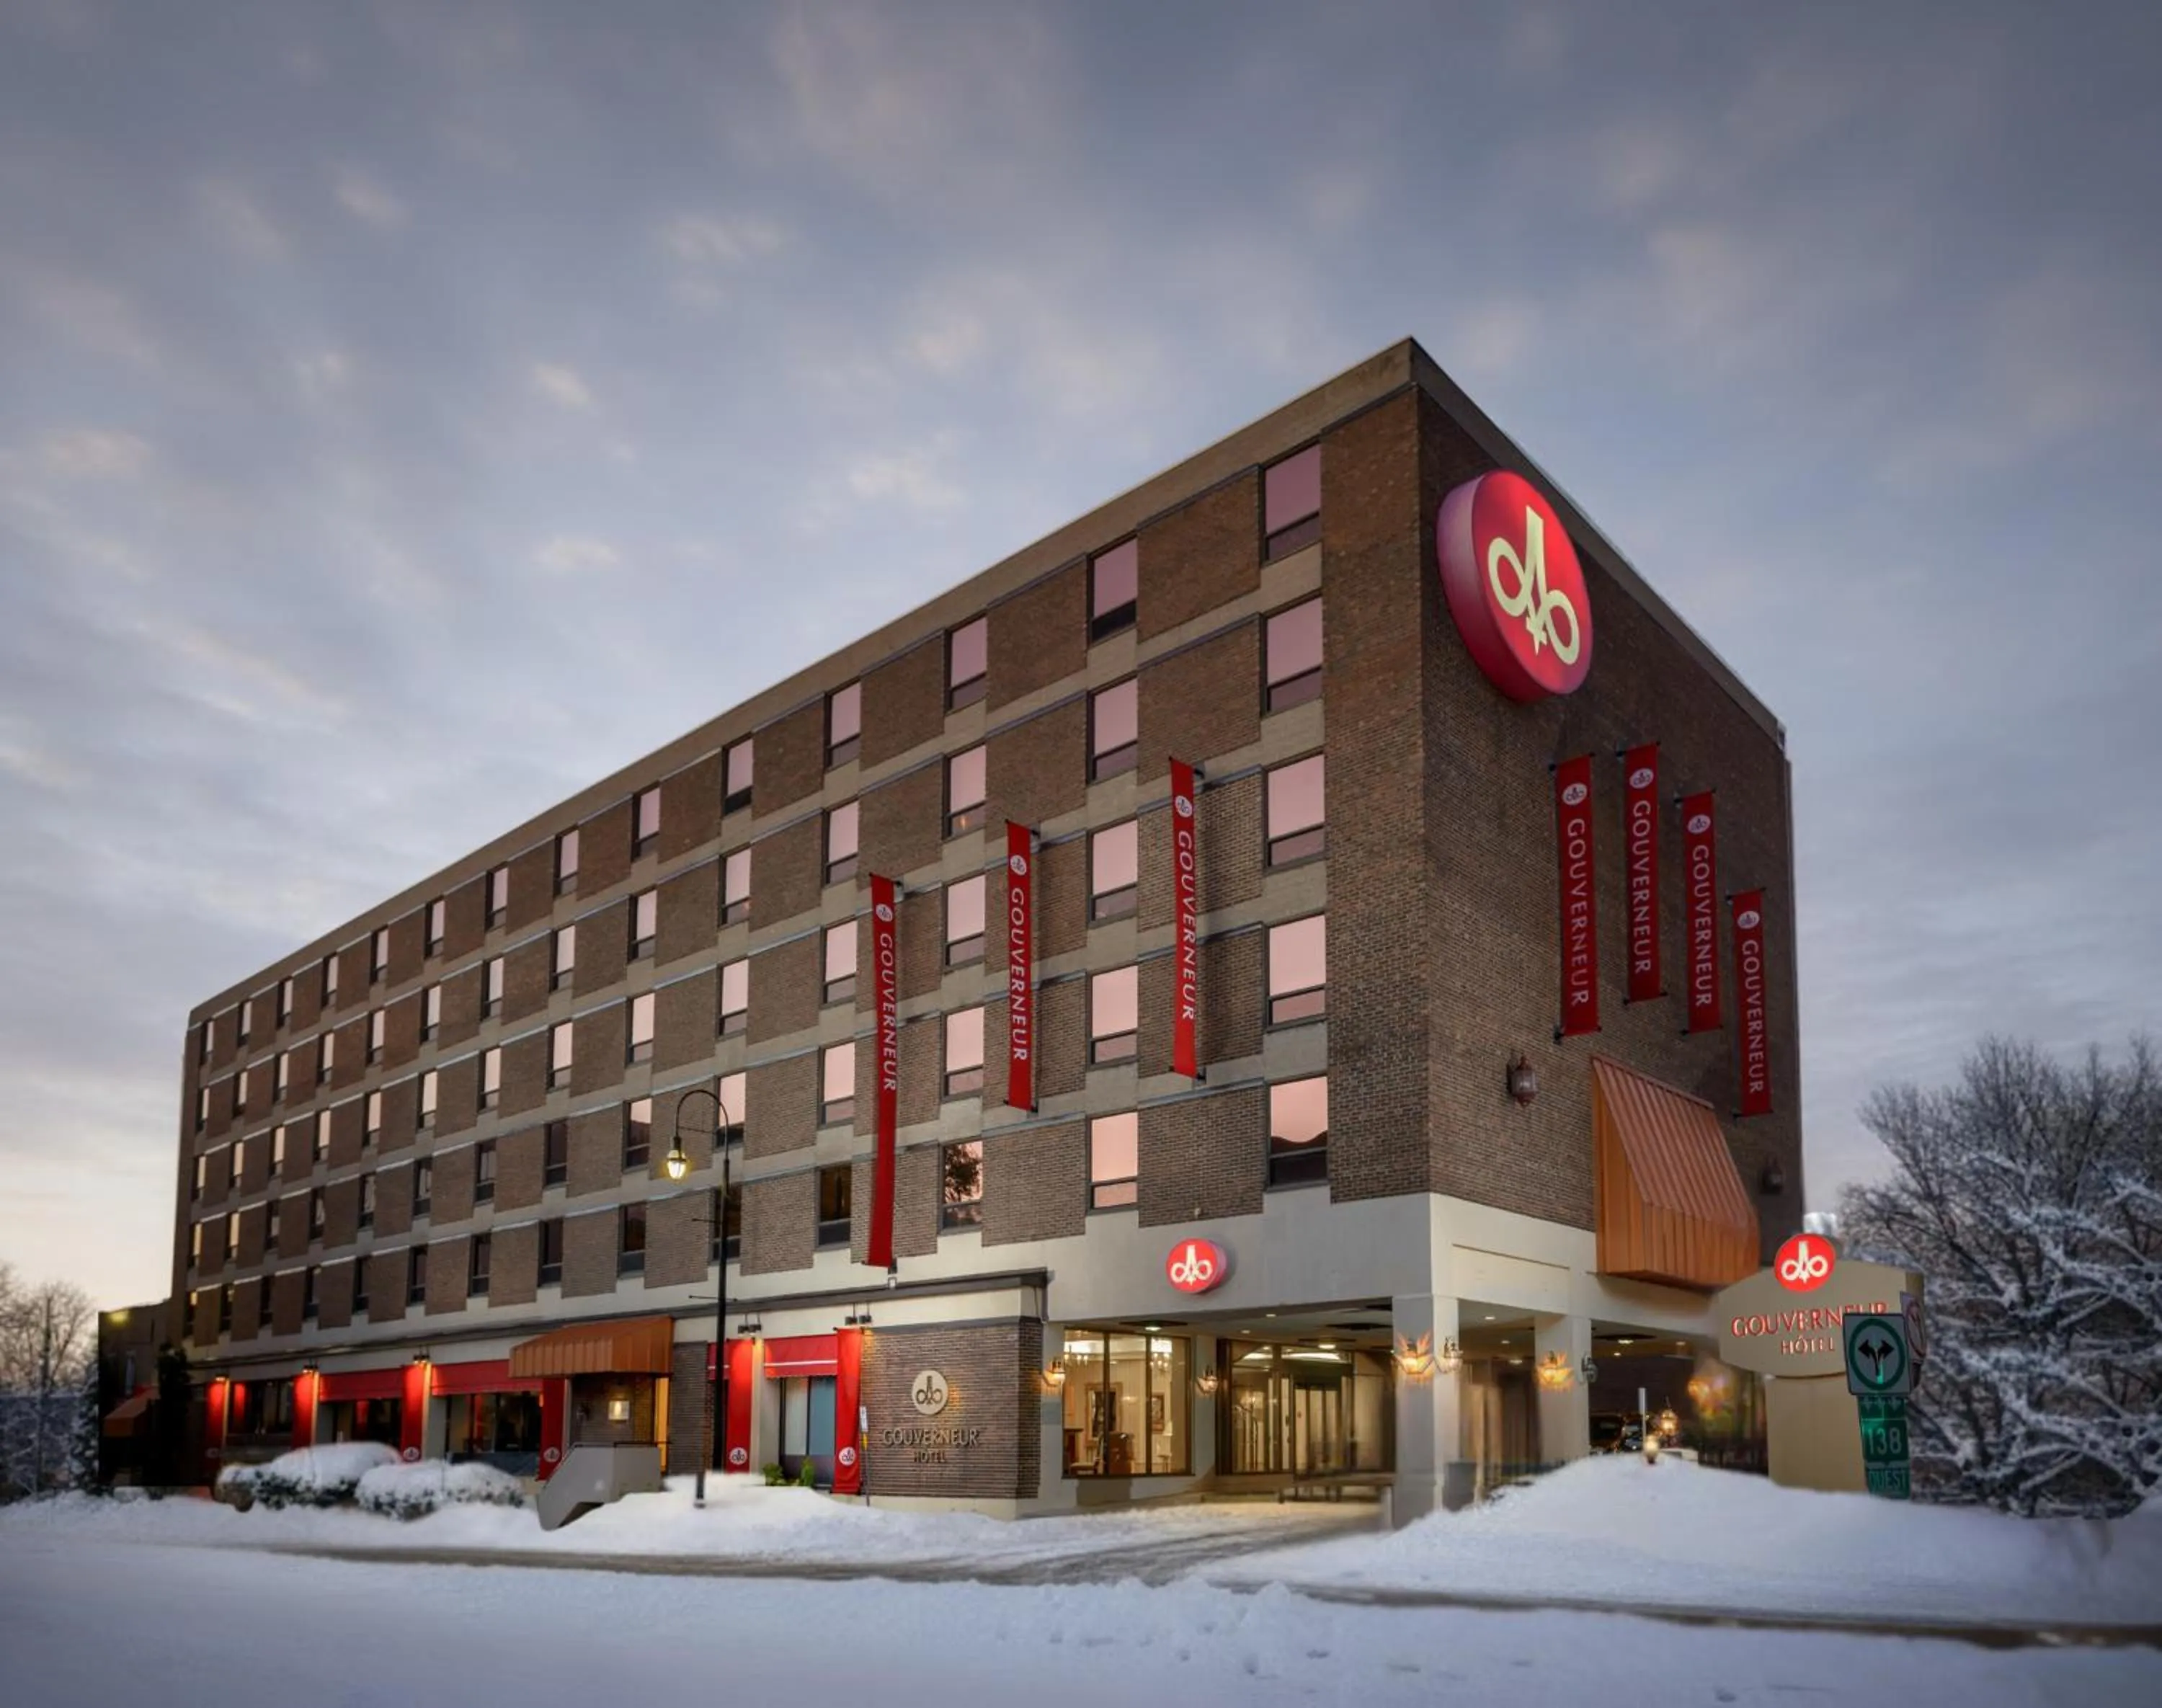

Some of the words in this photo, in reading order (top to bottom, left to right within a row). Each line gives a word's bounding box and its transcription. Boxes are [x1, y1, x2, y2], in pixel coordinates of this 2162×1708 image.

[1178, 831, 1196, 1020] GOUVERNEUR
[1567, 818, 1589, 1006] GOUVERNEUR
[1632, 799, 1651, 974] GOUVERNEUR
[1692, 844, 1712, 1007] GOUVERNEUR
[880, 933, 897, 1090] GOUVERNEUR
[1011, 887, 1027, 1060] GOUVERNEUR
[1742, 940, 1764, 1093] GOUVERNEUR
[884, 1428, 979, 1447] GOUVERNEUR
[1868, 1427, 1903, 1455] 138
